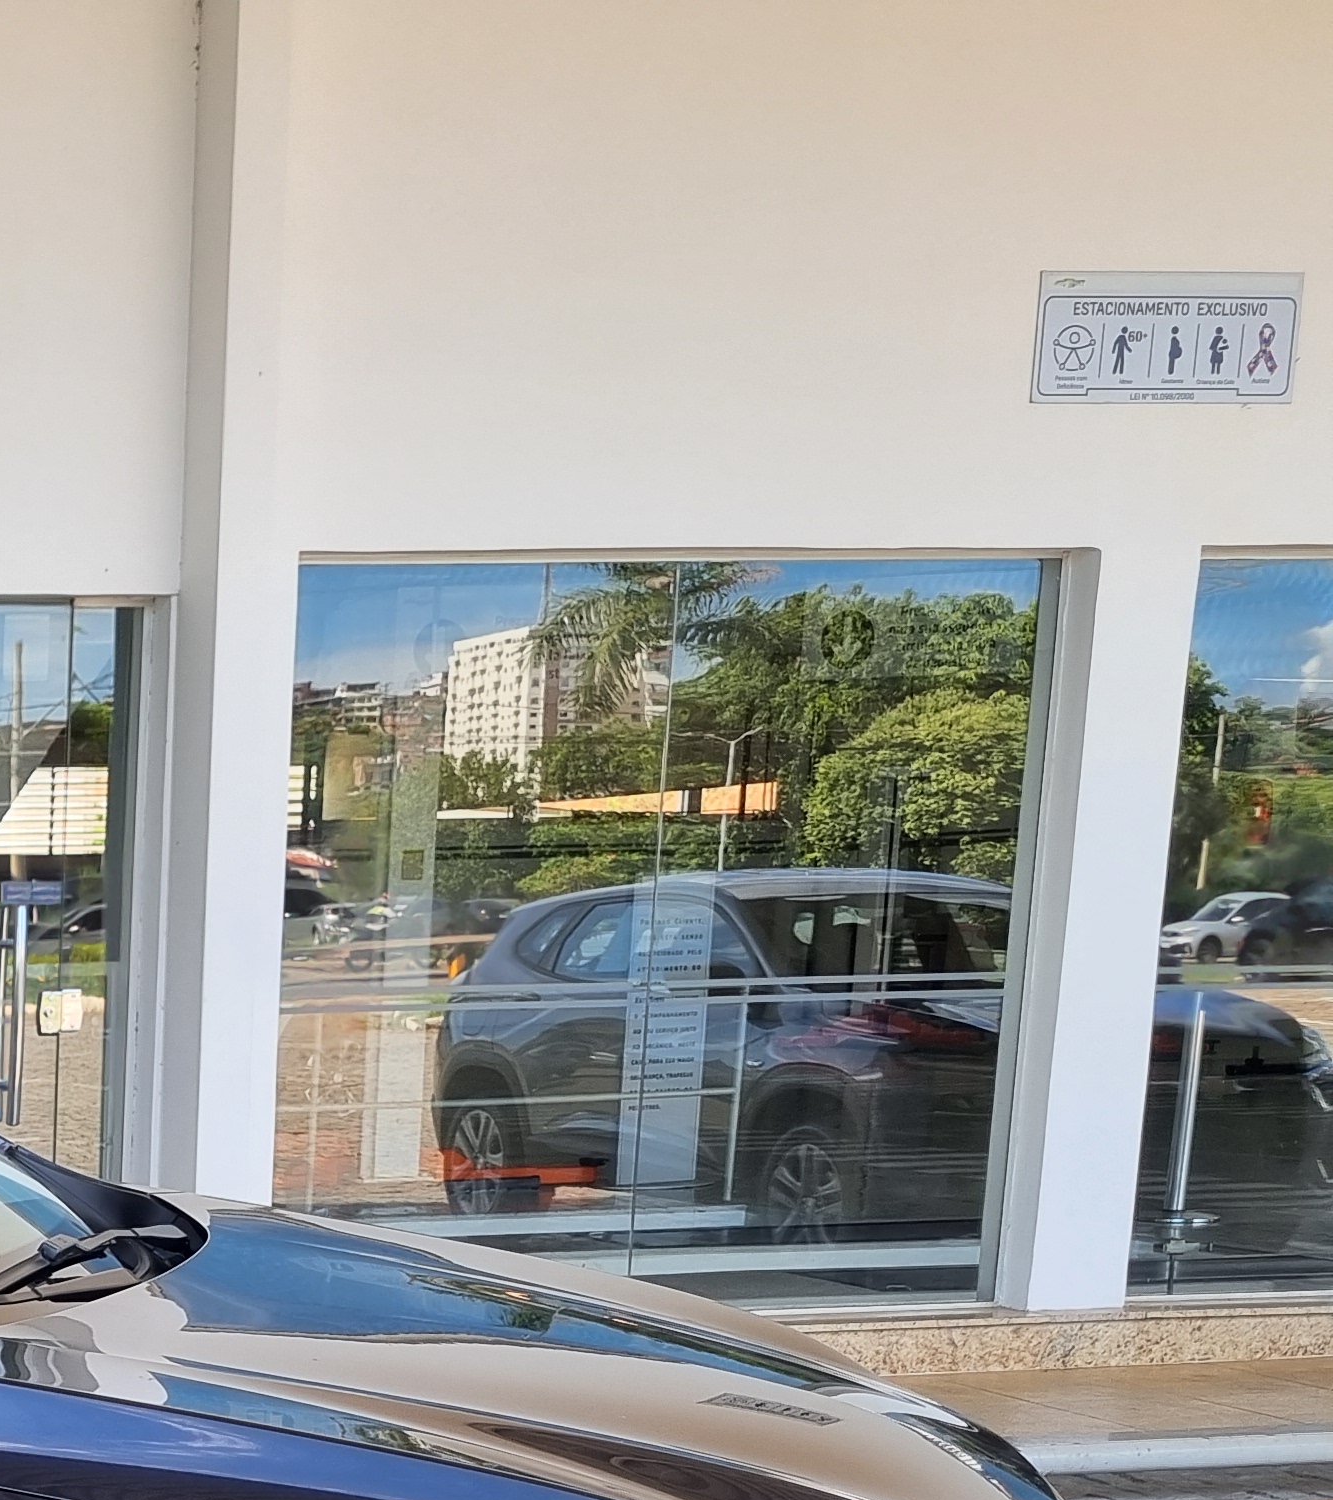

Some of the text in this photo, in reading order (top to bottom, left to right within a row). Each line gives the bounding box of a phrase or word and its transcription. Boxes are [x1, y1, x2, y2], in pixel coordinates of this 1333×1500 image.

[1073, 301, 1268, 317] ESTACIONAMENTO EXCLUSIVO
[1128, 330, 1148, 342] 60+
